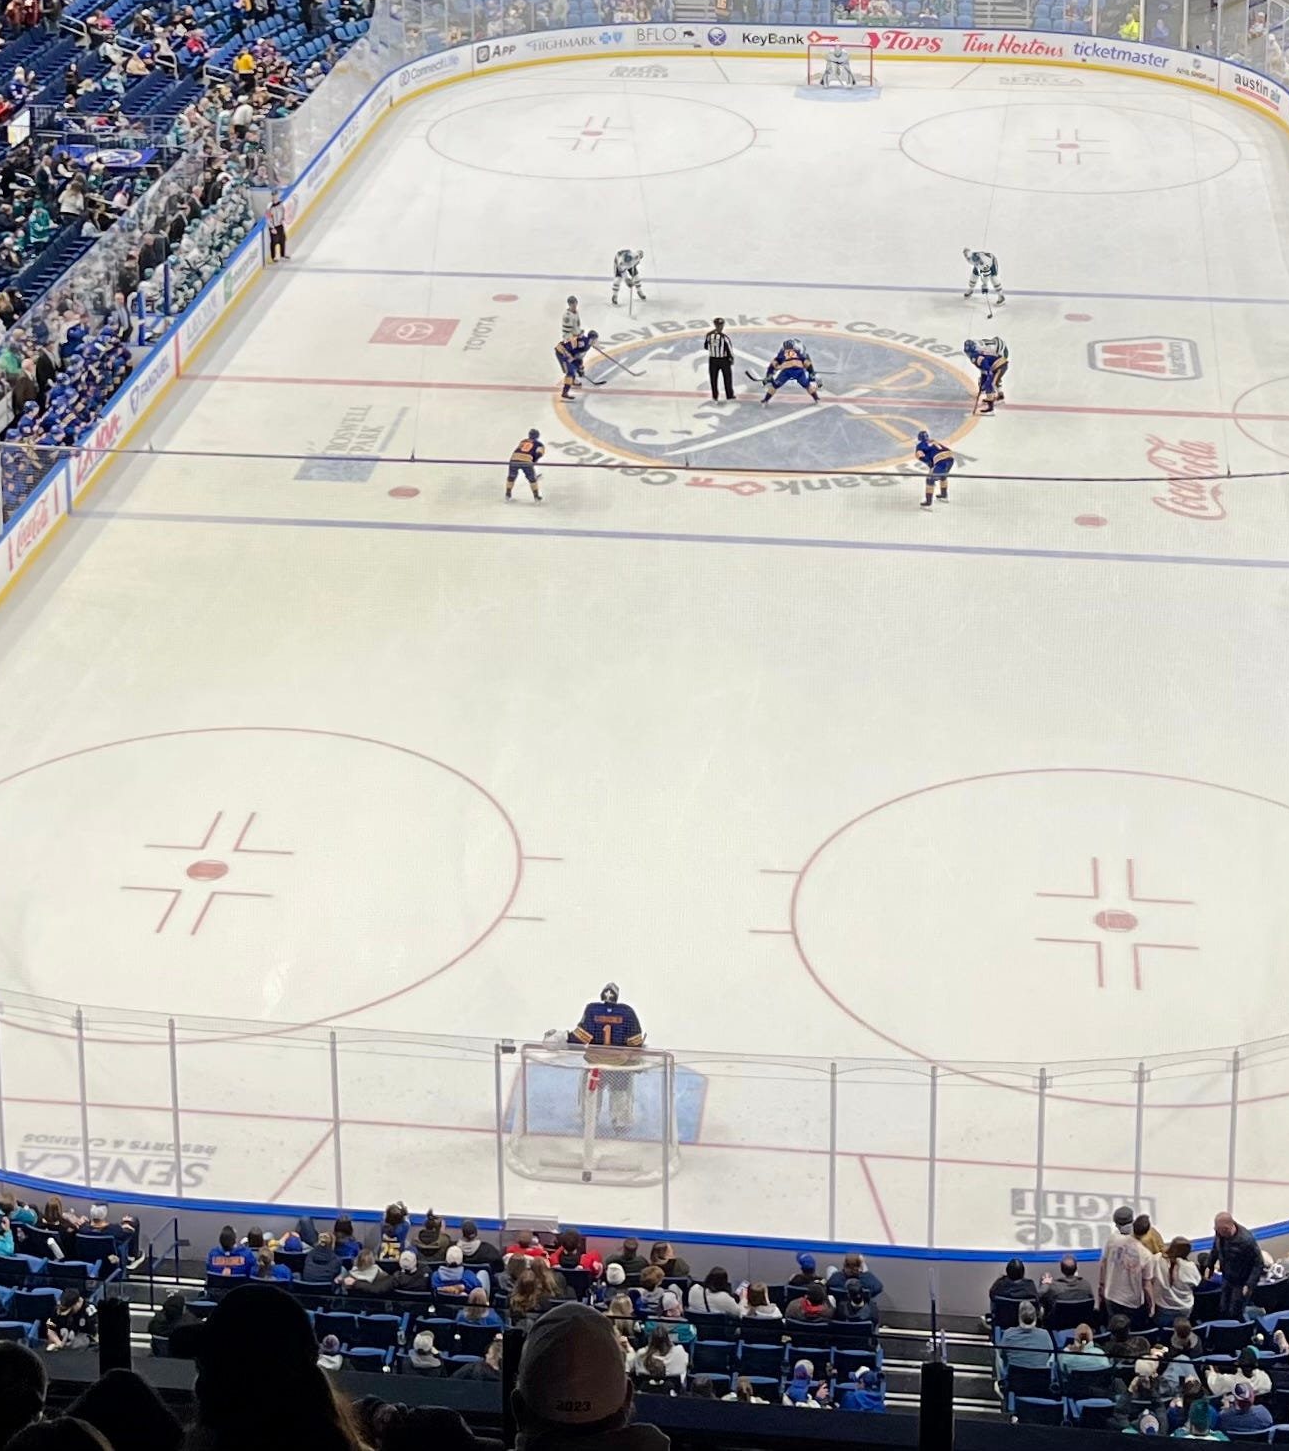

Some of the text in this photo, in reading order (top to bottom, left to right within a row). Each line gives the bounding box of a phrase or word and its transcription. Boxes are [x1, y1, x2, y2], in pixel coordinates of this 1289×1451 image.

[533, 36, 597, 52] HIGHMARK
[636, 27, 676, 42] BFLO
[741, 31, 804, 46] KeyBank
[962, 33, 1065, 58] Tim Hortons
[1073, 41, 1170, 68] ticketmaster
[1234, 71, 1269, 96] austin
[463, 315, 498, 352] TOYOTA
[845, 320, 964, 358] Center
[326, 405, 373, 455] ROSWELL
[349, 425, 384, 454] PARK
[603, 1024, 612, 1045] 1
[16, 1150, 210, 1189] SENECA
